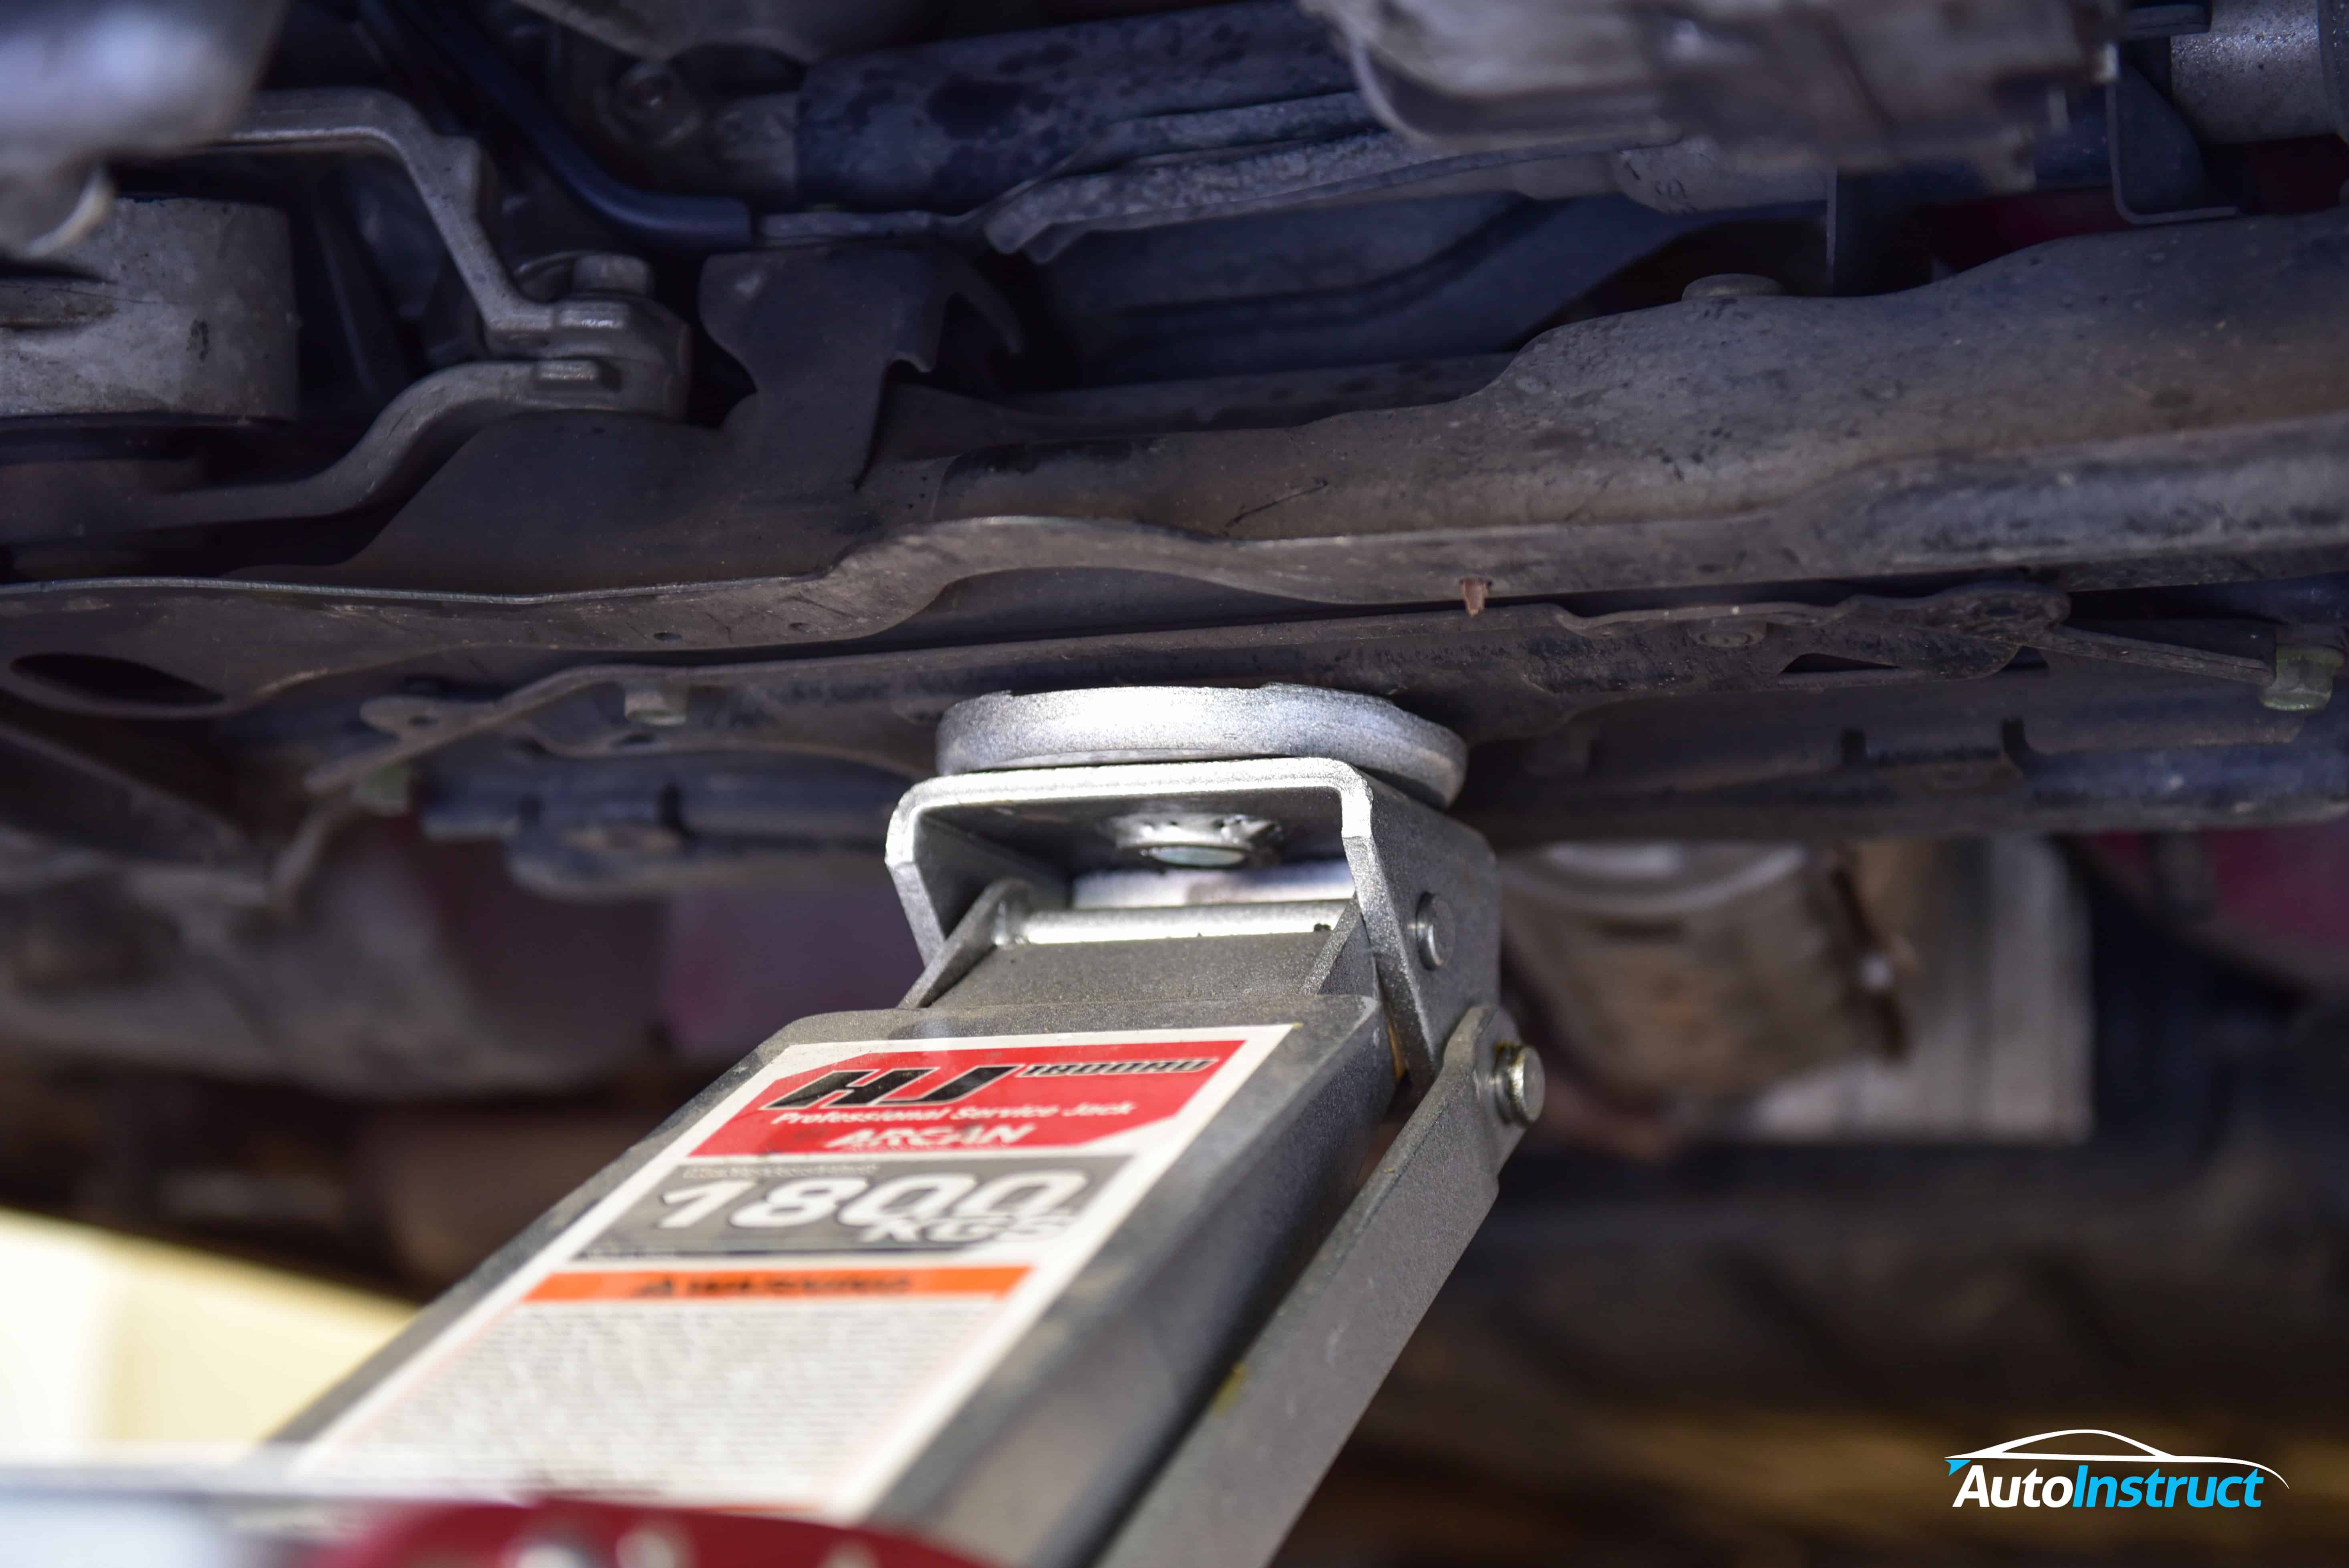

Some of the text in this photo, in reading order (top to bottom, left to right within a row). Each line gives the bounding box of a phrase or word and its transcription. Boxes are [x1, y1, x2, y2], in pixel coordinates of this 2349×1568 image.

[763, 1065, 1021, 1109] HJ
[771, 1102, 1135, 1124] Professional Service Jack
[825, 1124, 1037, 1147] ARCAN
[659, 1170, 1087, 1229] 1800
